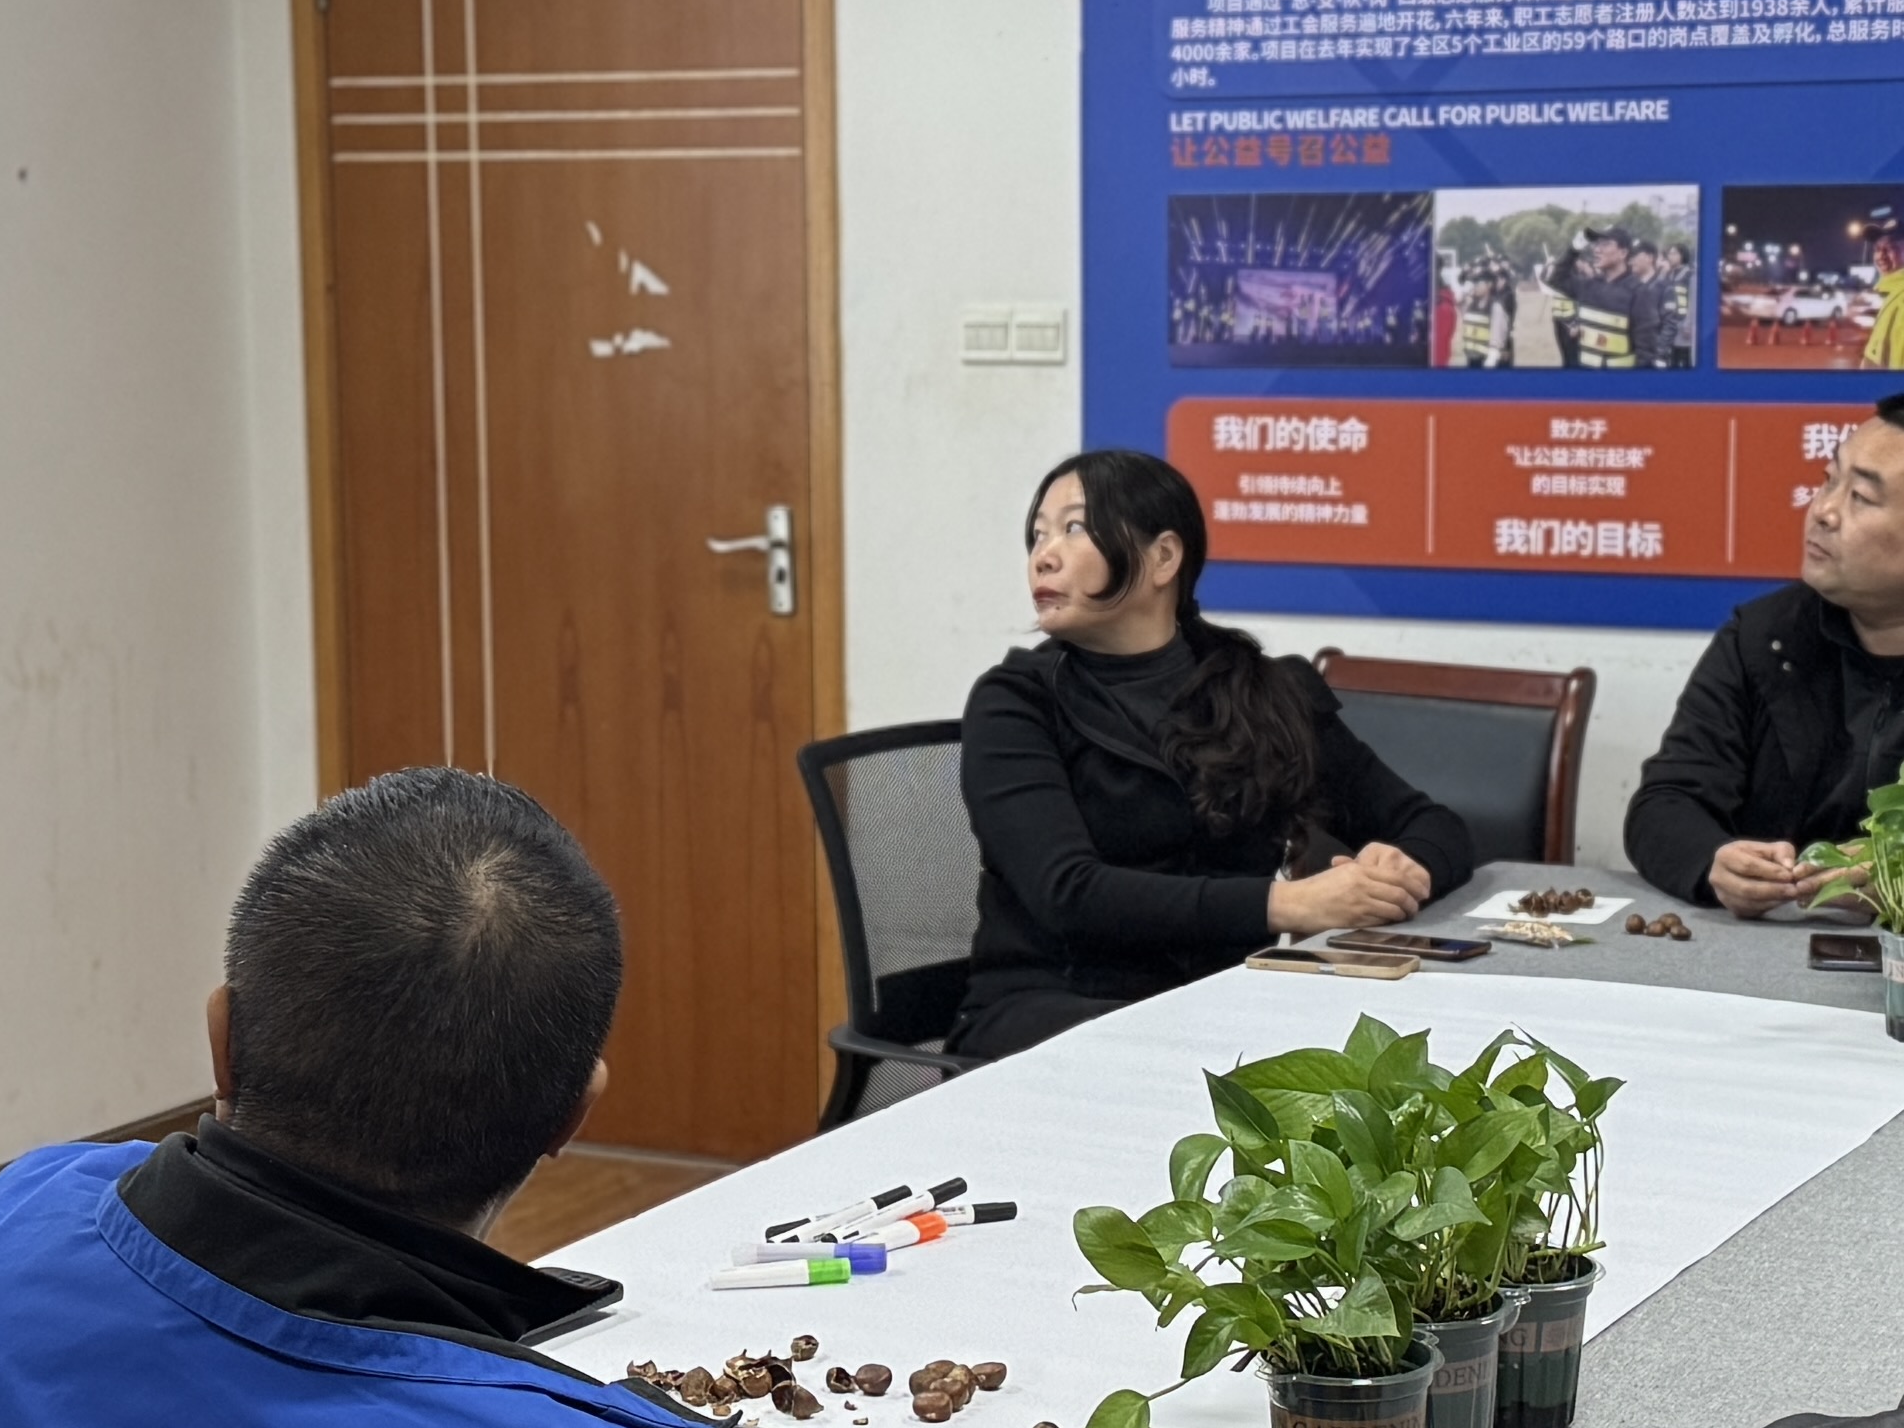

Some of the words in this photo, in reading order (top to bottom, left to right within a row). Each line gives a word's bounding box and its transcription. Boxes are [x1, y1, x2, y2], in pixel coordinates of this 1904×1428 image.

[1169, 111, 1207, 133] LET
[1208, 109, 1284, 132] PUBLIC
[1285, 106, 1381, 130] WELFARE
[1382, 104, 1435, 128] CALL
[1438, 104, 1482, 126] FOR
[1485, 102, 1565, 124] PUBLIC
[1566, 99, 1670, 122] WELFARE
[1213, 415, 1369, 453] 我们的使命
[1493, 517, 1664, 559] 我们的目标
